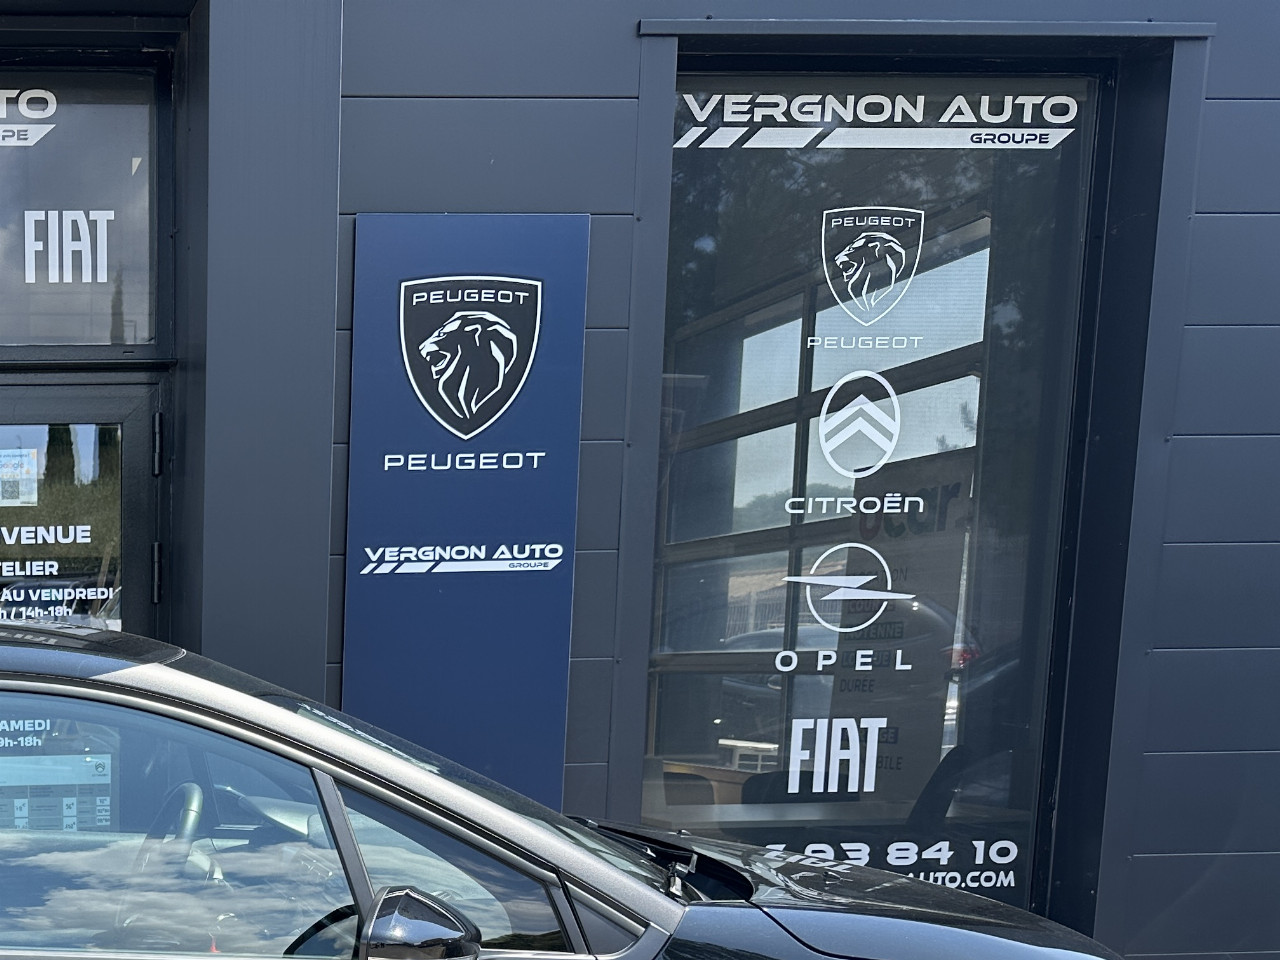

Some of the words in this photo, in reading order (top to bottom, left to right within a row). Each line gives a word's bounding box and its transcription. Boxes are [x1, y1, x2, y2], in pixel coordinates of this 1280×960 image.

[681, 93, 925, 124] VERGNON
[938, 93, 1079, 124] AUTO
[969, 131, 1051, 146] GROUPE
[829, 215, 917, 229] PEUGEOT
[23, 210, 115, 285] FIAT
[410, 289, 531, 306] PEUGEOT
[806, 335, 925, 350] PEUGEOT
[383, 451, 547, 471] PEUGEOT
[784, 492, 925, 514] CITROËN
[365, 545, 487, 562] VERGNON
[492, 542, 565, 561] AUTO
[508, 561, 550, 571] GROUPE
[0, 589, 25, 602] AU
[28, 587, 114, 602] VENDREDI
[19, 604, 73, 620] 14h-18h
[774, 650, 913, 673] OPEL
[787, 717, 888, 794] FIAT
[886, 840, 955, 866] 84
[971, 839, 1019, 865] 10
[907, 870, 1016, 888] UTO.COM
